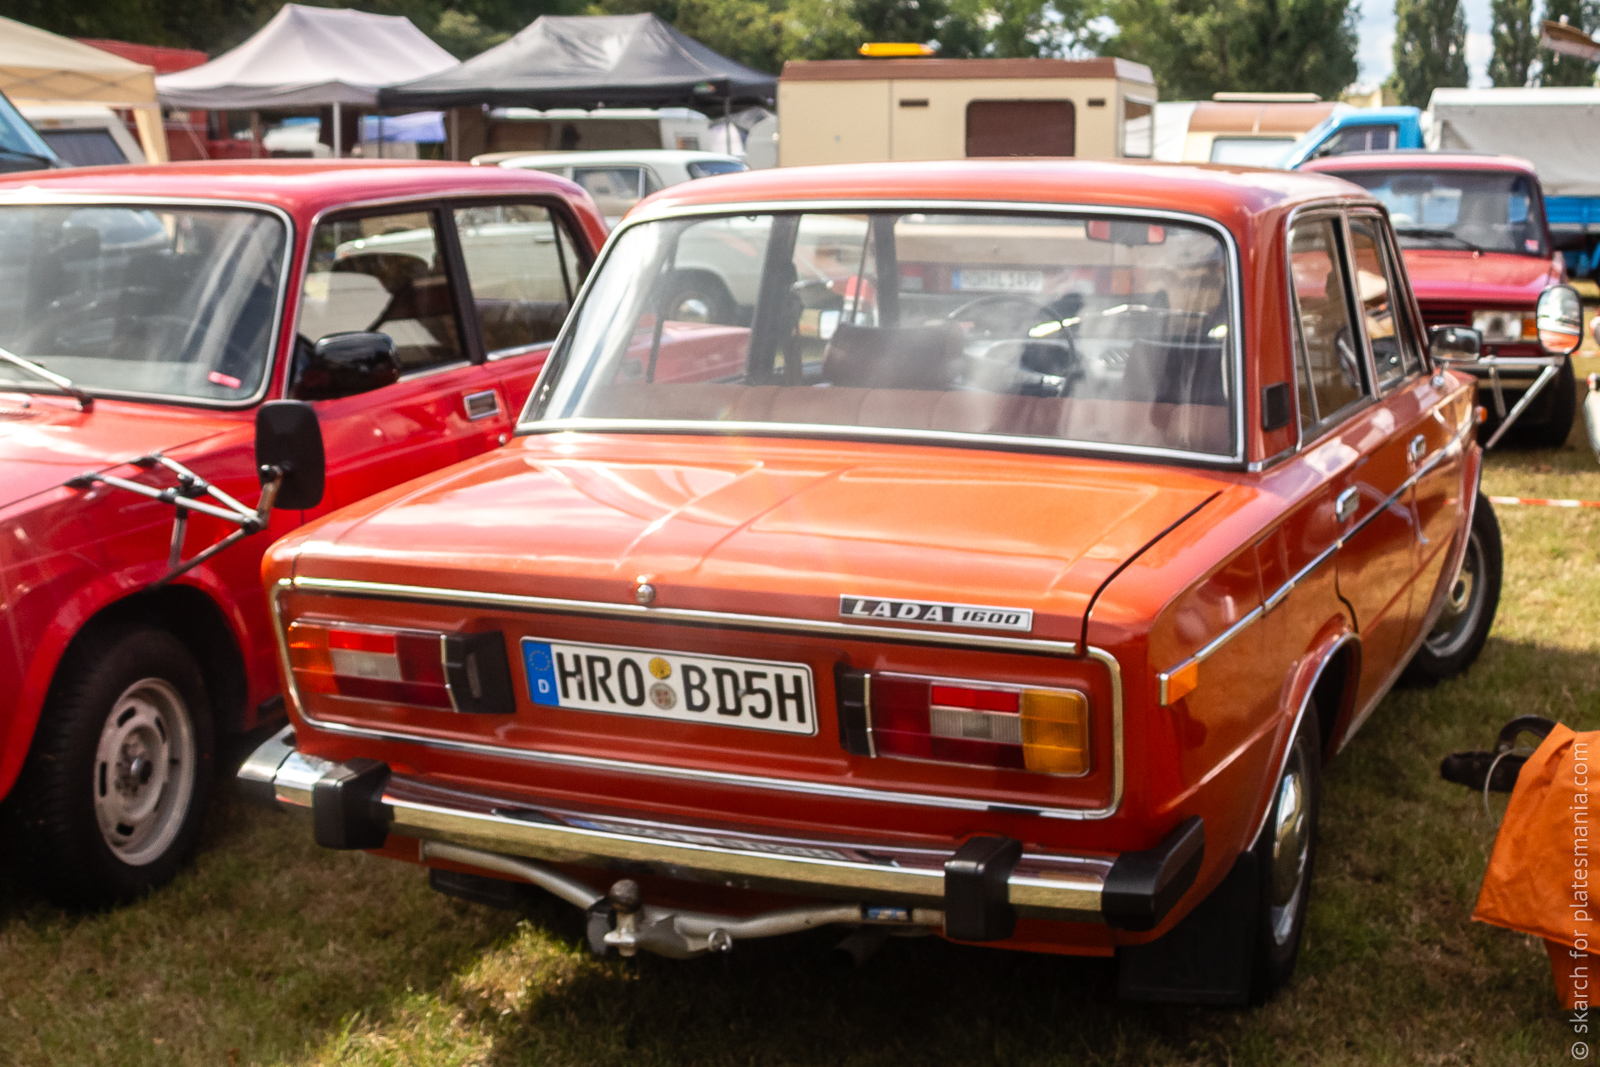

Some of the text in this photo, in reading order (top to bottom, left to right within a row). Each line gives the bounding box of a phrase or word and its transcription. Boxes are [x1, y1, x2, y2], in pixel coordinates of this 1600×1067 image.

[852, 600, 1021, 625] LADA 1600
[538, 679, 550, 694] D
[556, 651, 807, 724] HRO BD5H
